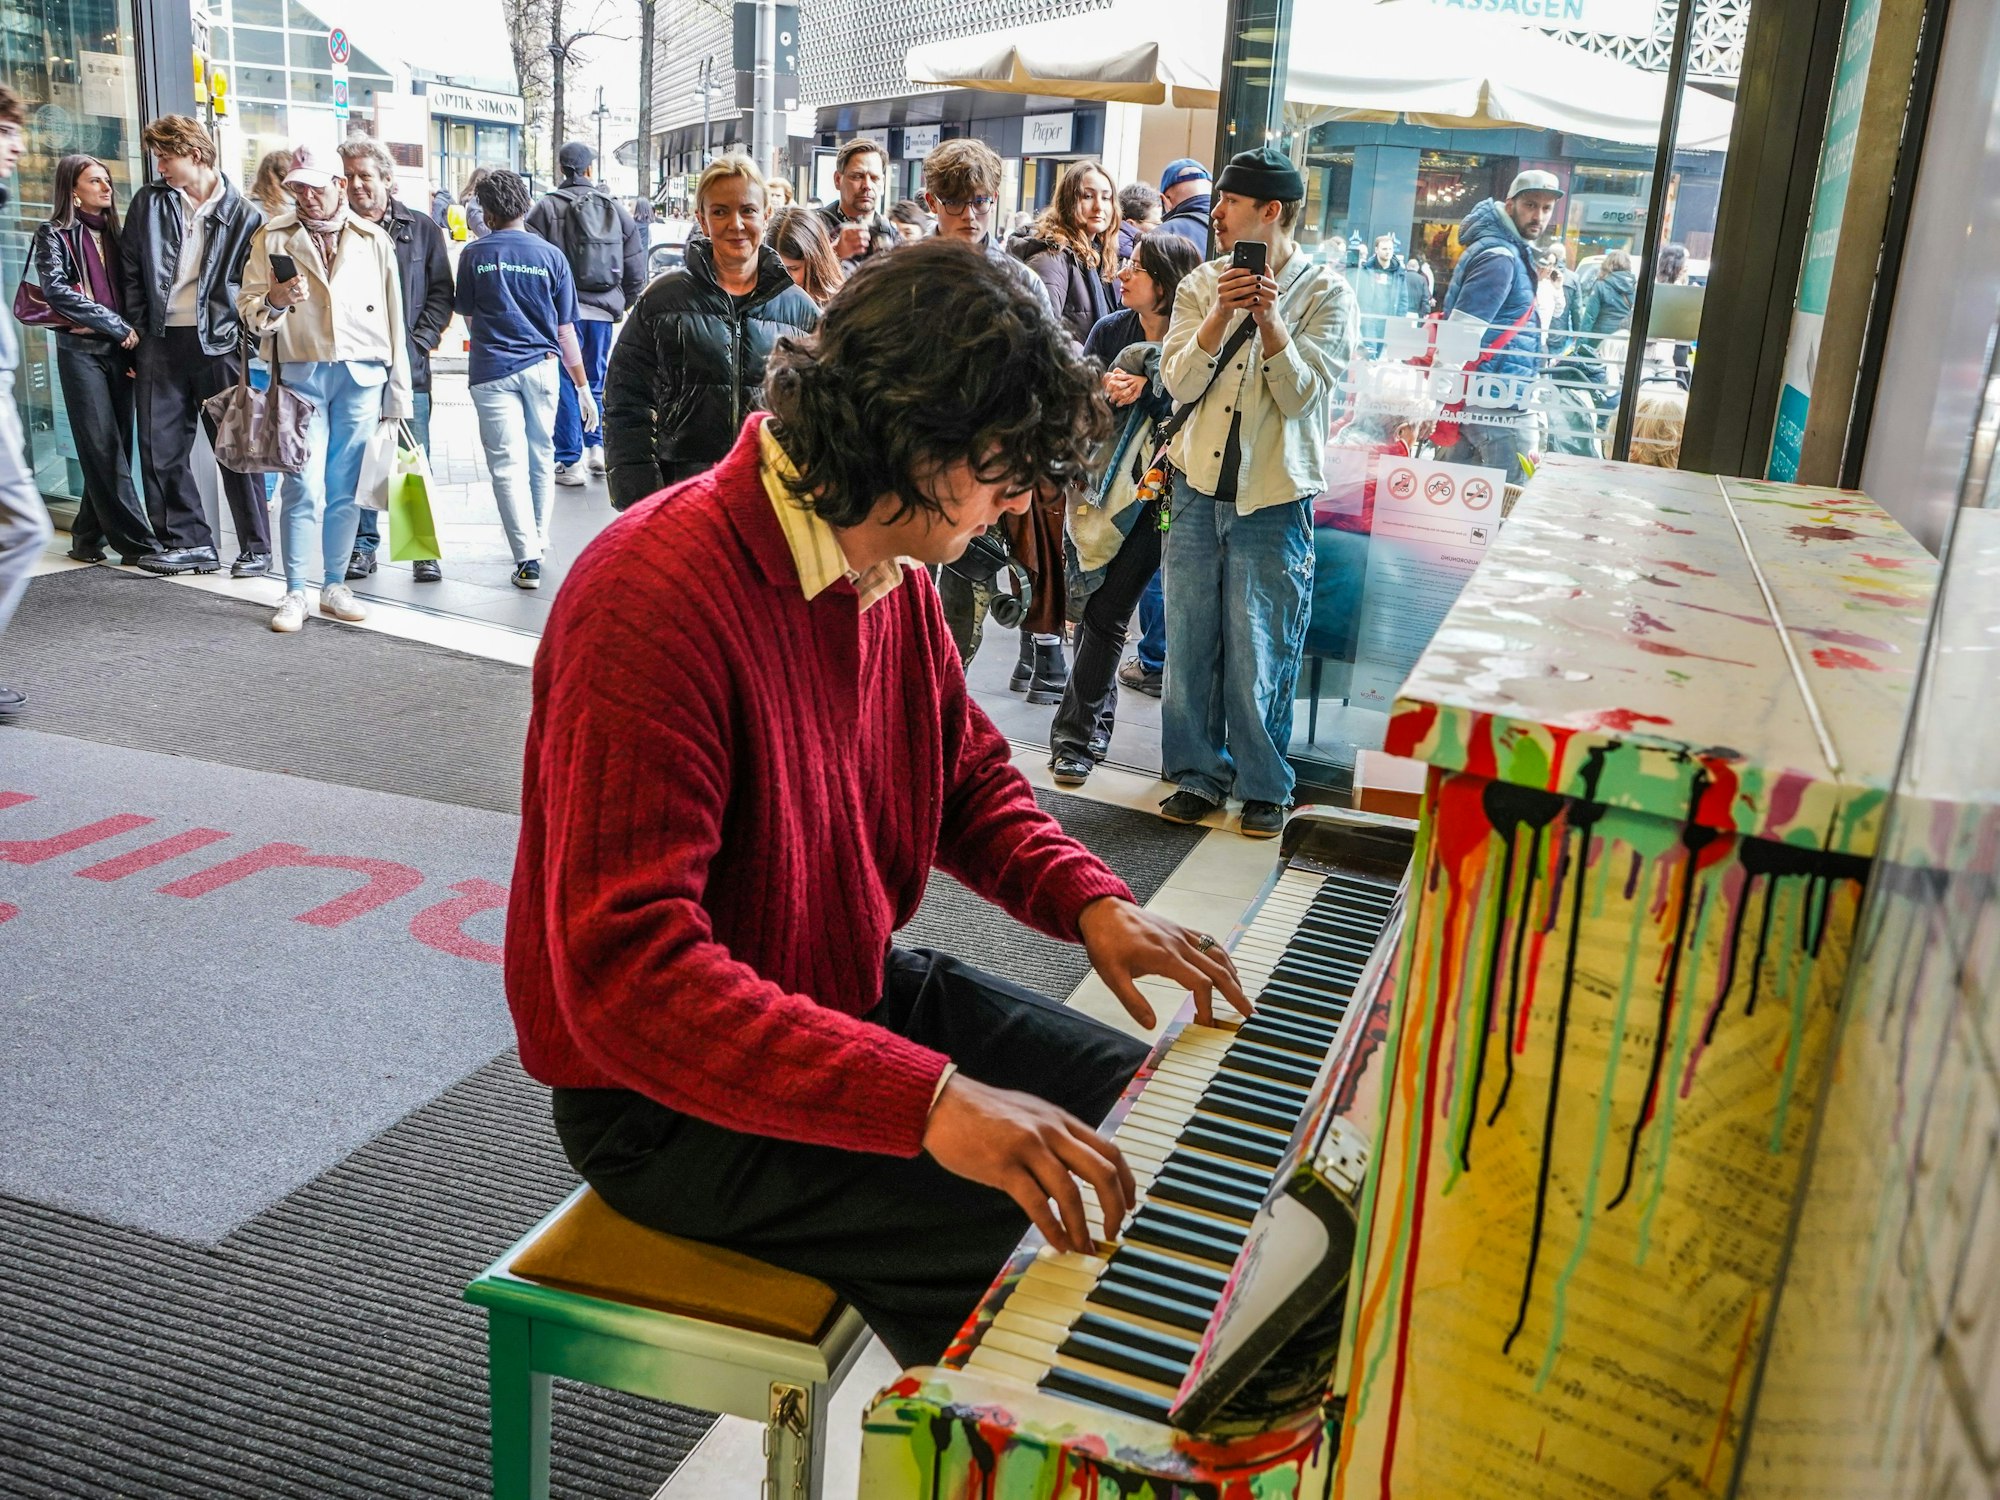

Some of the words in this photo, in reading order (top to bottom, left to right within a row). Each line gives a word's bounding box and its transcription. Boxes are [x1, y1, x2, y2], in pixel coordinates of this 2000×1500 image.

[434, 93, 473, 111] OPTIK
[477, 99, 517, 117] SIMON
[1032, 121, 1063, 147] Pieper
[477, 263, 498, 274] Rein
[500, 261, 549, 277] Persönlich
